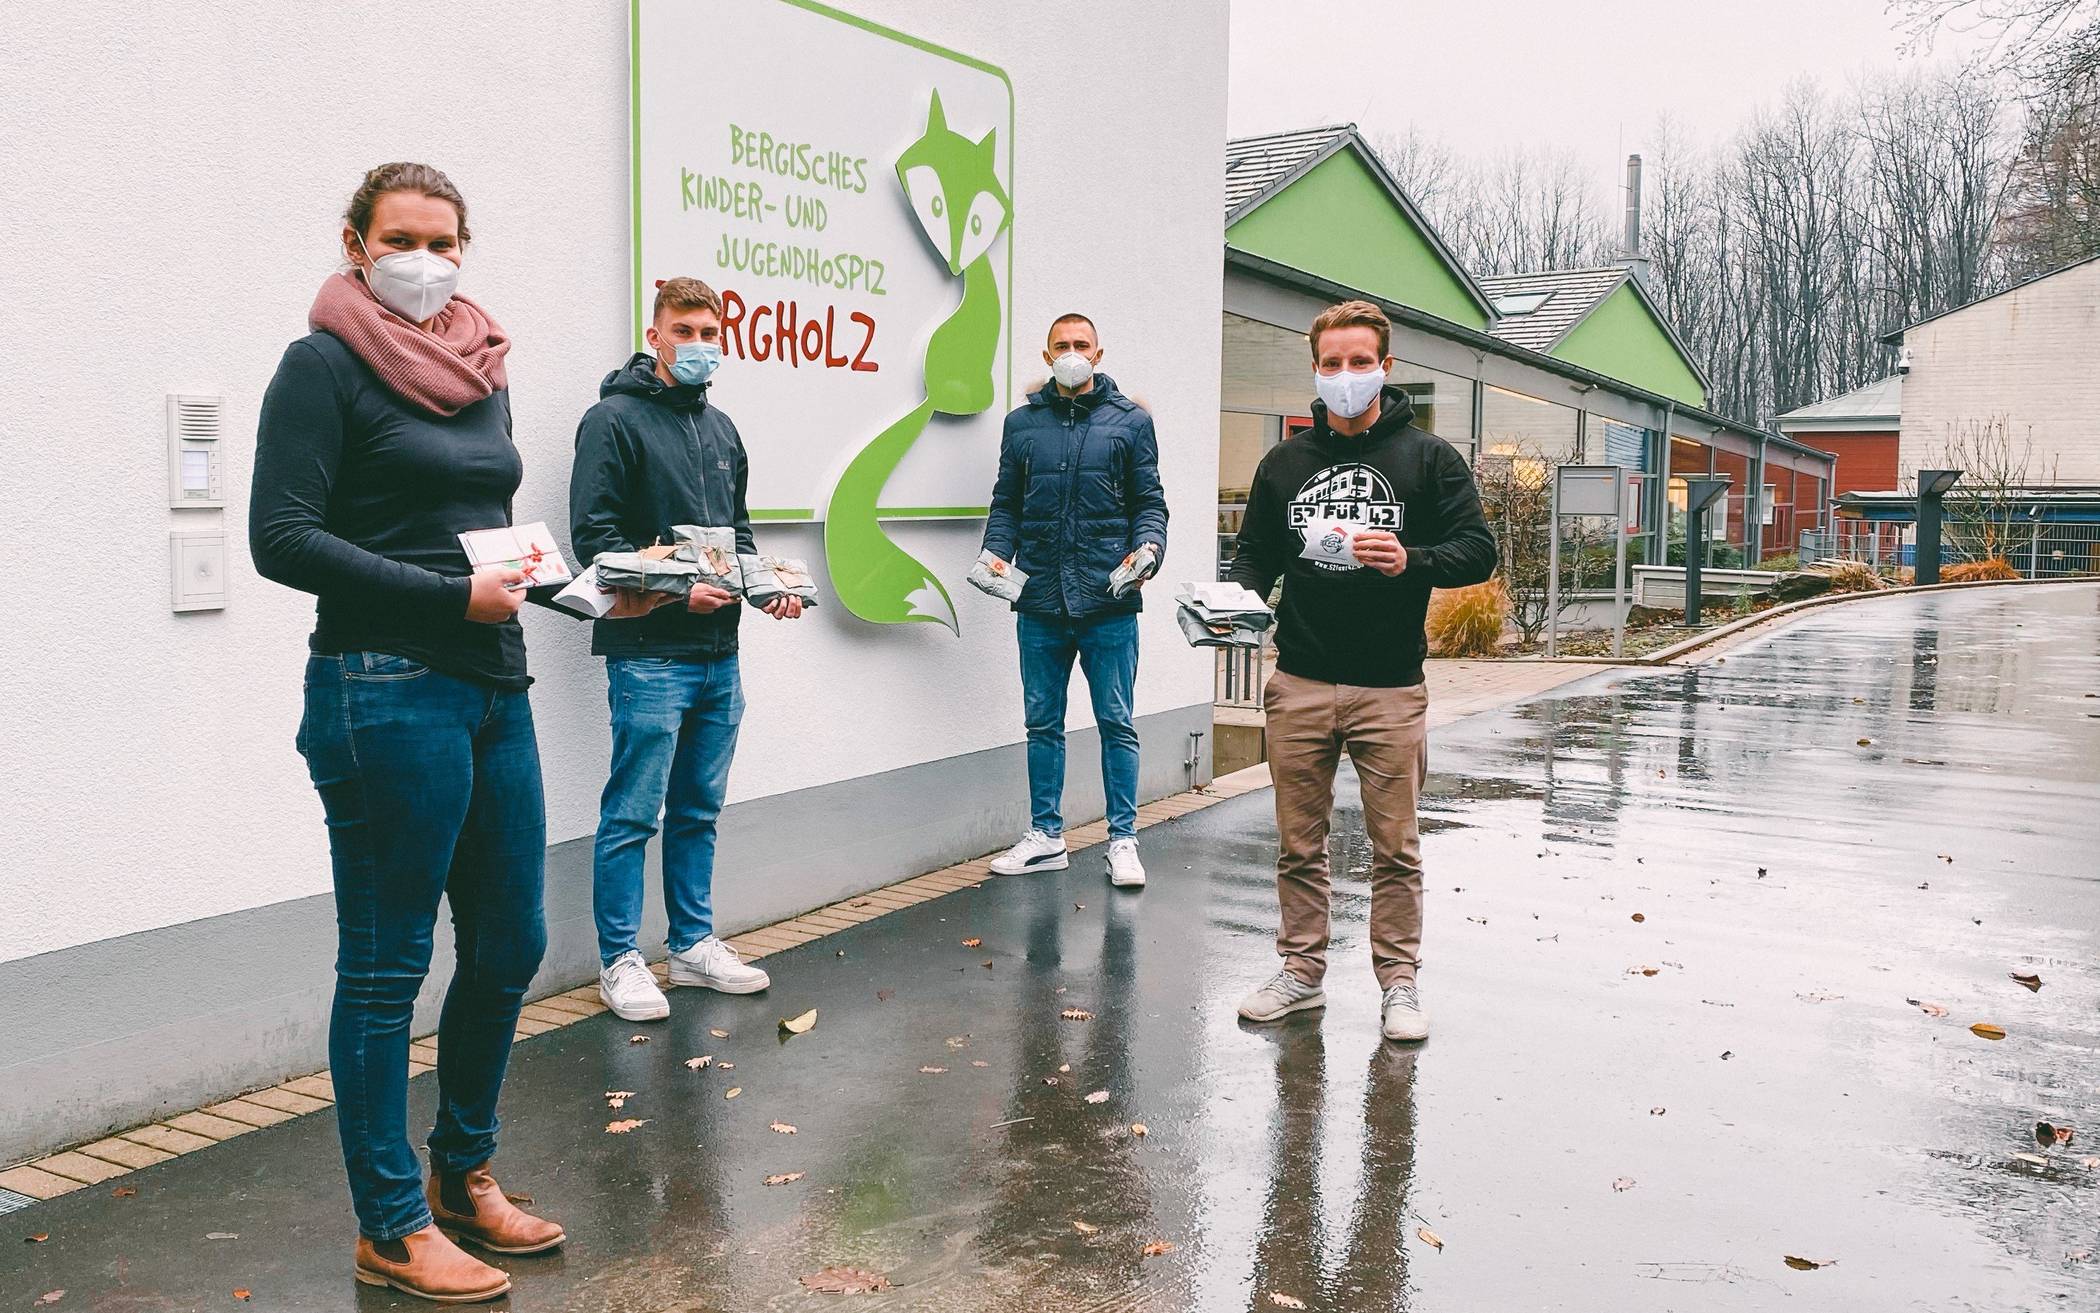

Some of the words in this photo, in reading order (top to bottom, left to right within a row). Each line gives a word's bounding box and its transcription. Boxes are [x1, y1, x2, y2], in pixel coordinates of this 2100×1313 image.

[729, 123, 868, 194] BERGISCHES
[785, 194, 828, 232] UND
[716, 233, 887, 296] JUGENDHOSPIZ
[655, 279, 879, 372] RGHOLZ
[1323, 503, 1361, 521] FÜR
[1370, 507, 1396, 526] 42
